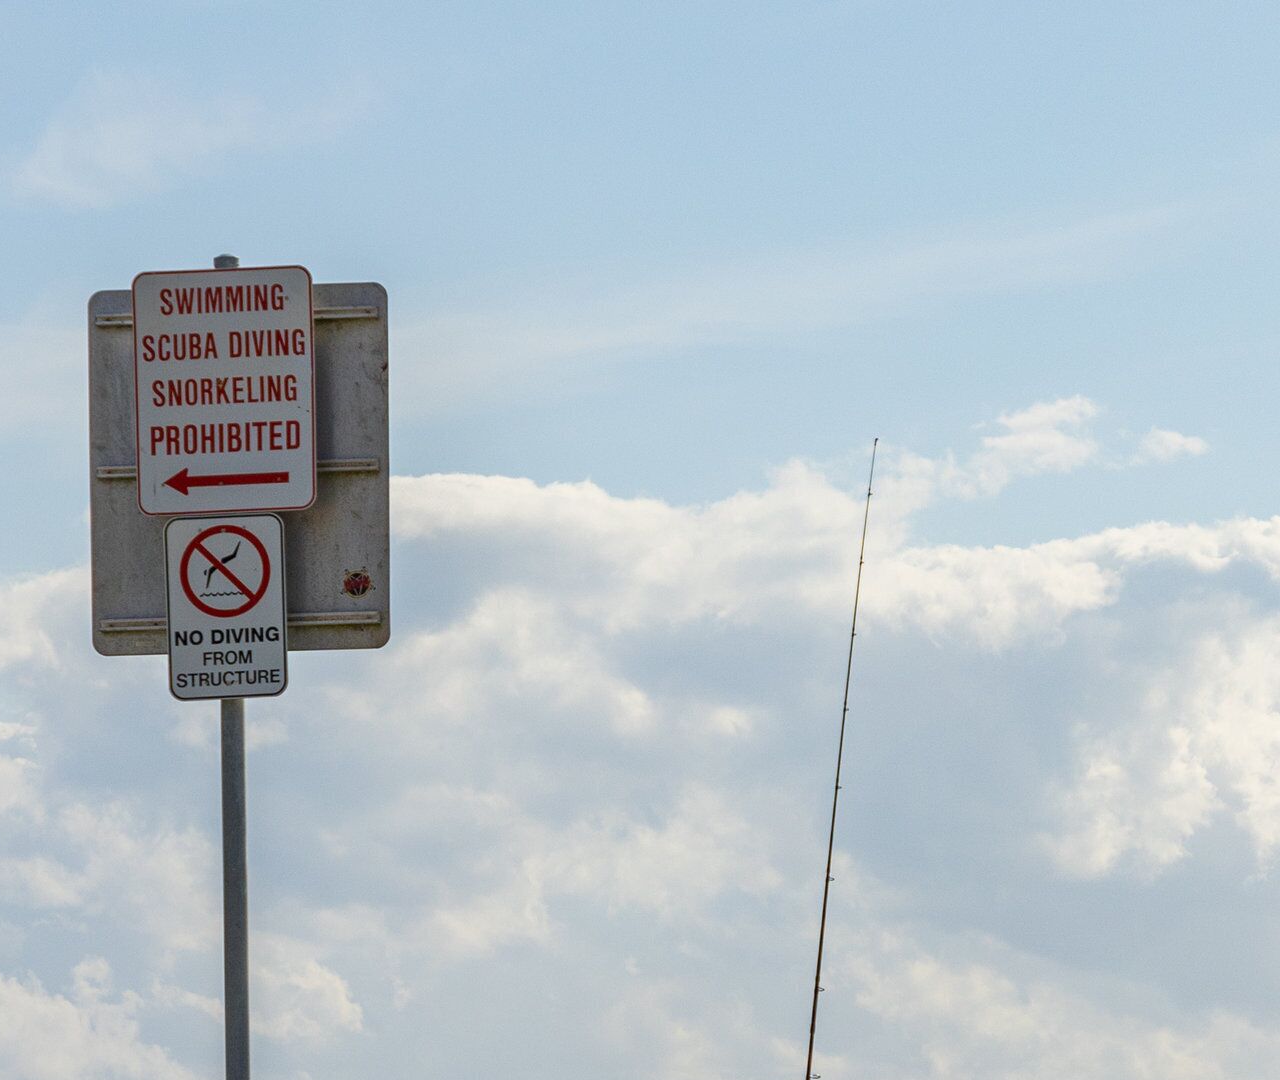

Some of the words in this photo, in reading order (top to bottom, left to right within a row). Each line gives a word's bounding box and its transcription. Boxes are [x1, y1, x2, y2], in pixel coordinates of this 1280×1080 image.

[159, 283, 285, 316] SWIMMING
[141, 332, 218, 362] SCUBA
[228, 328, 306, 358] DIVING
[151, 374, 298, 408] SNORKELING
[150, 420, 301, 456] PROHIBITED
[174, 630, 204, 646] NO
[210, 626, 280, 645] DIVING
[202, 650, 253, 666] FROM
[176, 669, 280, 688] STRUCTURE
